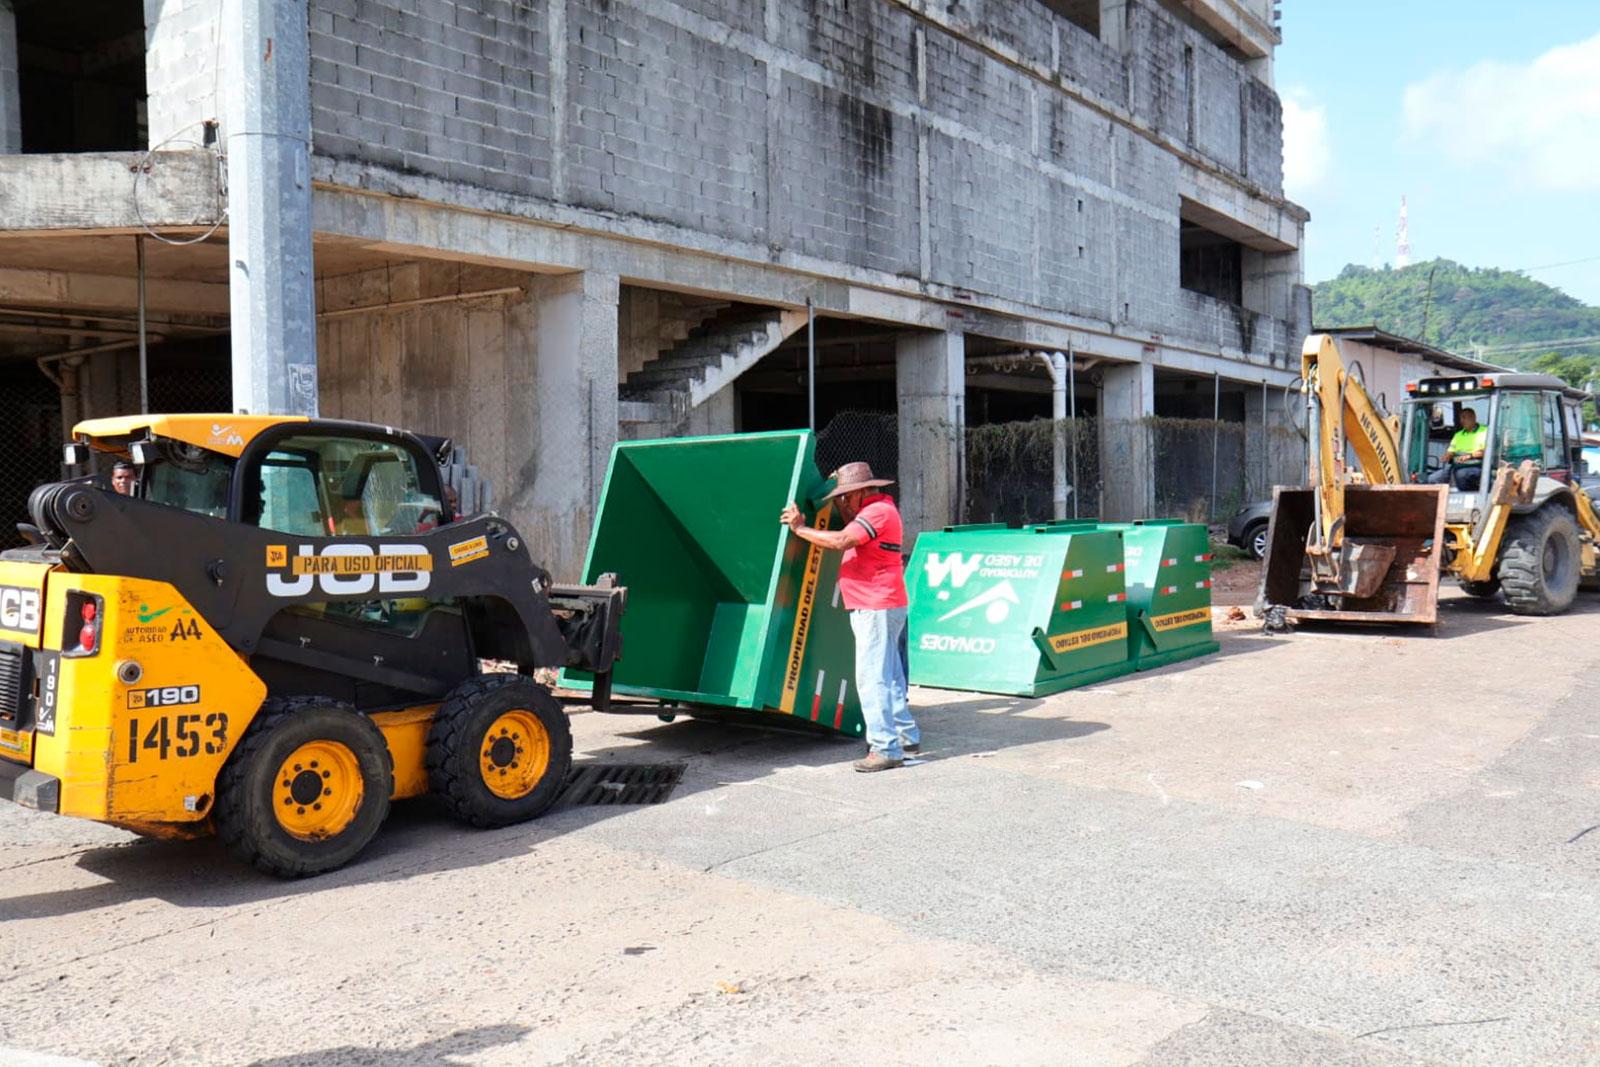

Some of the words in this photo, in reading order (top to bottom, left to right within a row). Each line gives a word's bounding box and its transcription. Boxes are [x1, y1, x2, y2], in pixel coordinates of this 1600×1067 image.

[1361, 413, 1377, 444] NEW
[1376, 441, 1395, 485] HOLLA
[304, 557, 338, 573] PARA
[344, 556, 370, 572] USO
[375, 555, 422, 571] OFICIAL
[985, 555, 1022, 566] ASEO
[1023, 555, 1043, 567] DE
[979, 567, 1040, 578] AUTORIDAD
[0, 588, 39, 630] CB
[787, 608, 809, 691] PROPIEDAD
[803, 578, 816, 607] DEL
[810, 518, 826, 575] ESTO
[139, 634, 163, 642] ASEO
[920, 633, 995, 653] CONADES
[1080, 635, 1091, 644] DEL
[147, 685, 199, 706] 190
[129, 712, 228, 763] 1453
